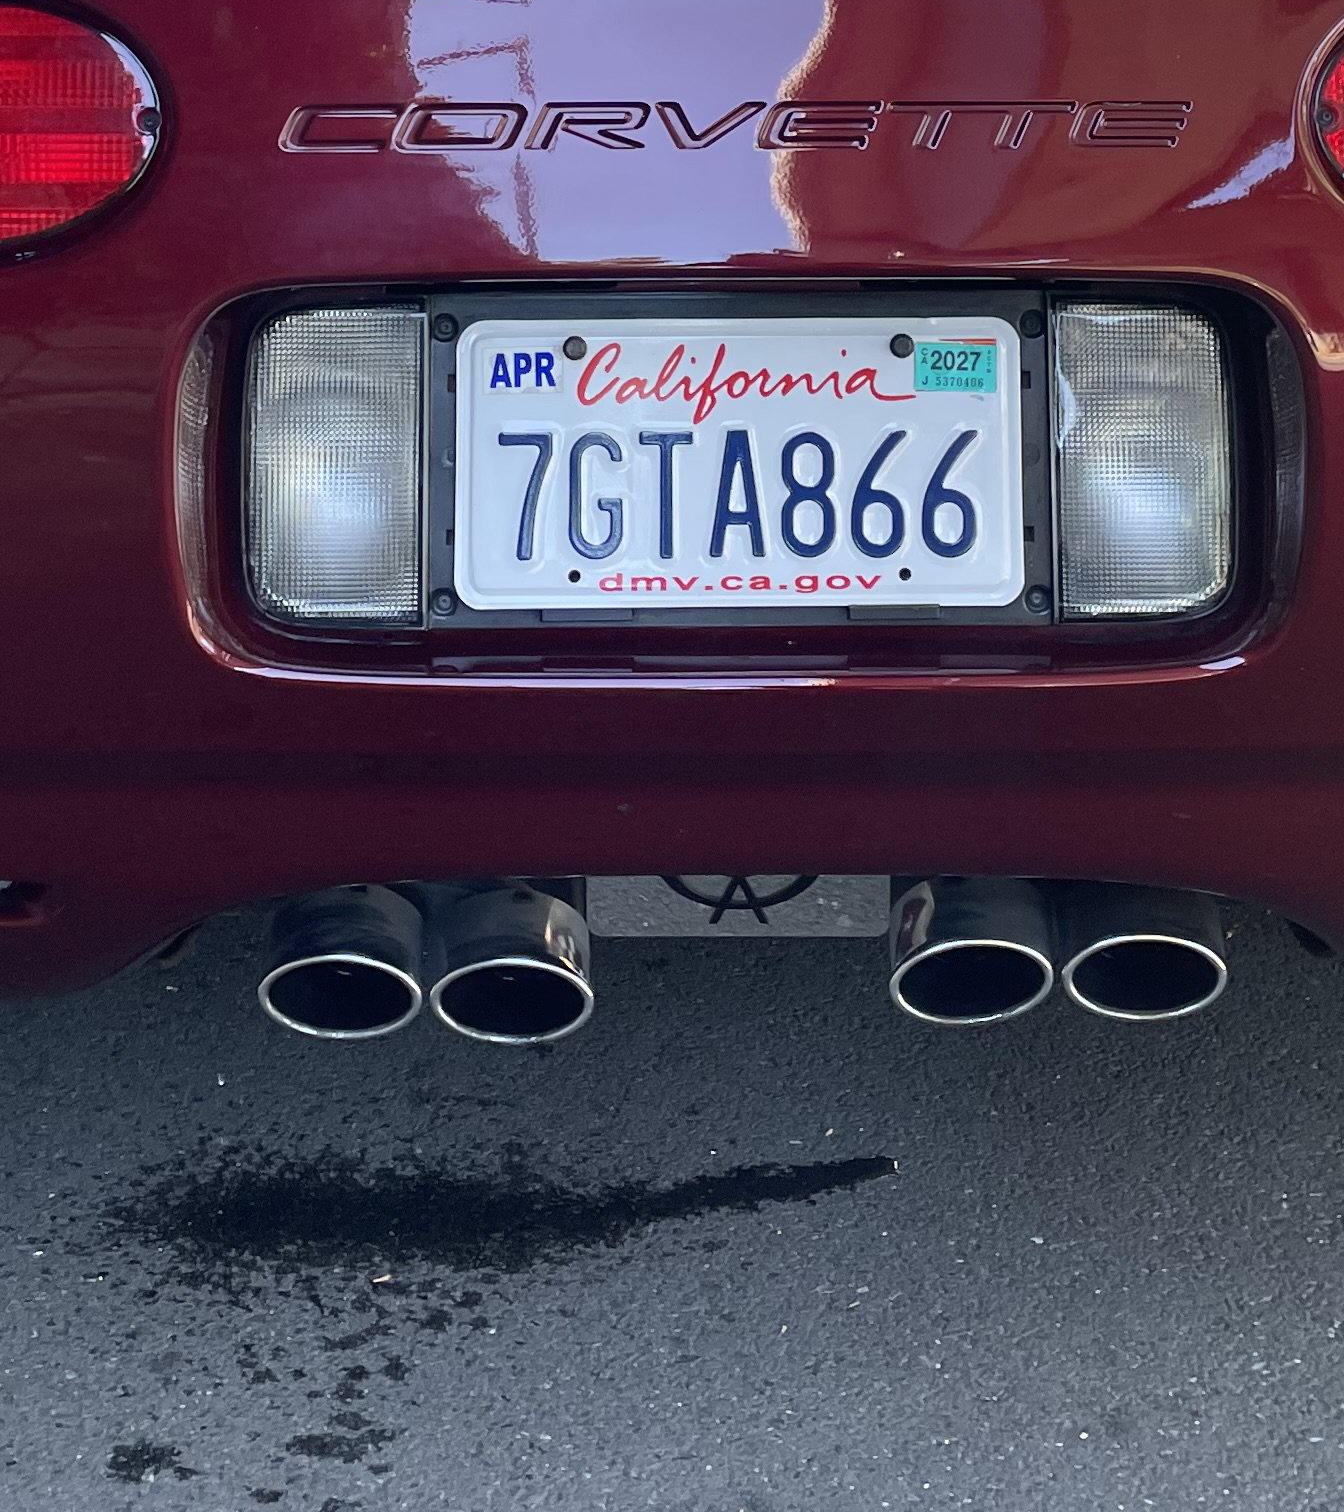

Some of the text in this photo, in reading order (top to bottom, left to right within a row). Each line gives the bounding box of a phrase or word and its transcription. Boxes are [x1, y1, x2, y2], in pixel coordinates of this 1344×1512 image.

[276, 99, 1194, 154] CORVETTE
[490, 351, 556, 390] APR
[577, 341, 918, 426] California
[930, 349, 982, 372] 2027
[497, 429, 979, 561] 7GTA866
[598, 572, 883, 595] dmv.ca.gov
